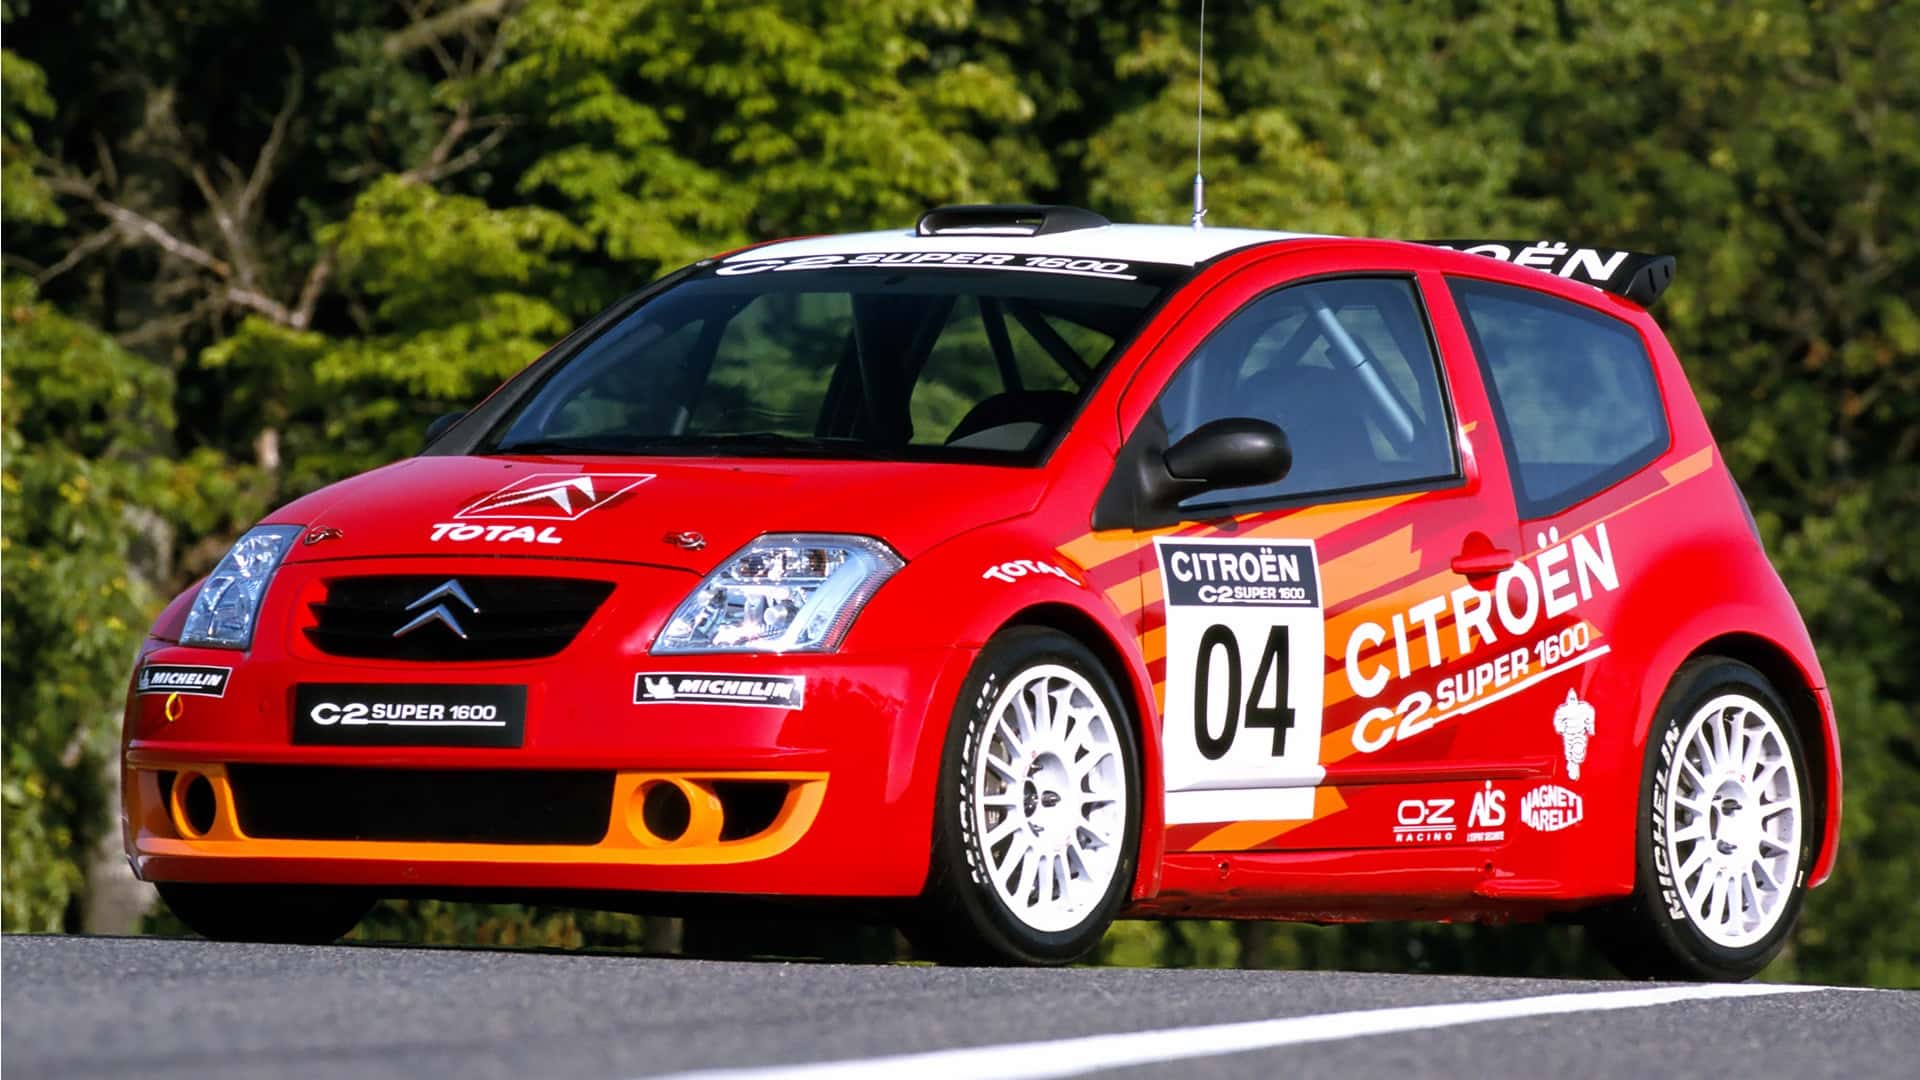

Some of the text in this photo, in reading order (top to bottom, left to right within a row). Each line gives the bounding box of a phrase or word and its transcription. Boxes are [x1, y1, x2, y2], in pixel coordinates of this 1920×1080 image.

[714, 253, 1129, 276] C2 SUPER 1600
[430, 522, 562, 544] TOTAL
[982, 559, 1081, 586] TOTAL
[1170, 547, 1301, 583] CITROËN
[1198, 585, 1306, 604] C2 SUPER 1600
[1345, 522, 1620, 698] CITROËN
[150, 672, 223, 687] MICHELIN
[677, 679, 794, 700] MICHELIN
[1351, 621, 1591, 753] C2 SUPER 1600
[1194, 624, 1296, 761] 04
[310, 702, 497, 725] C2 SUPER 1600
[1653, 719, 1684, 920] MICHELIN
[1395, 832, 1453, 842] RACING
